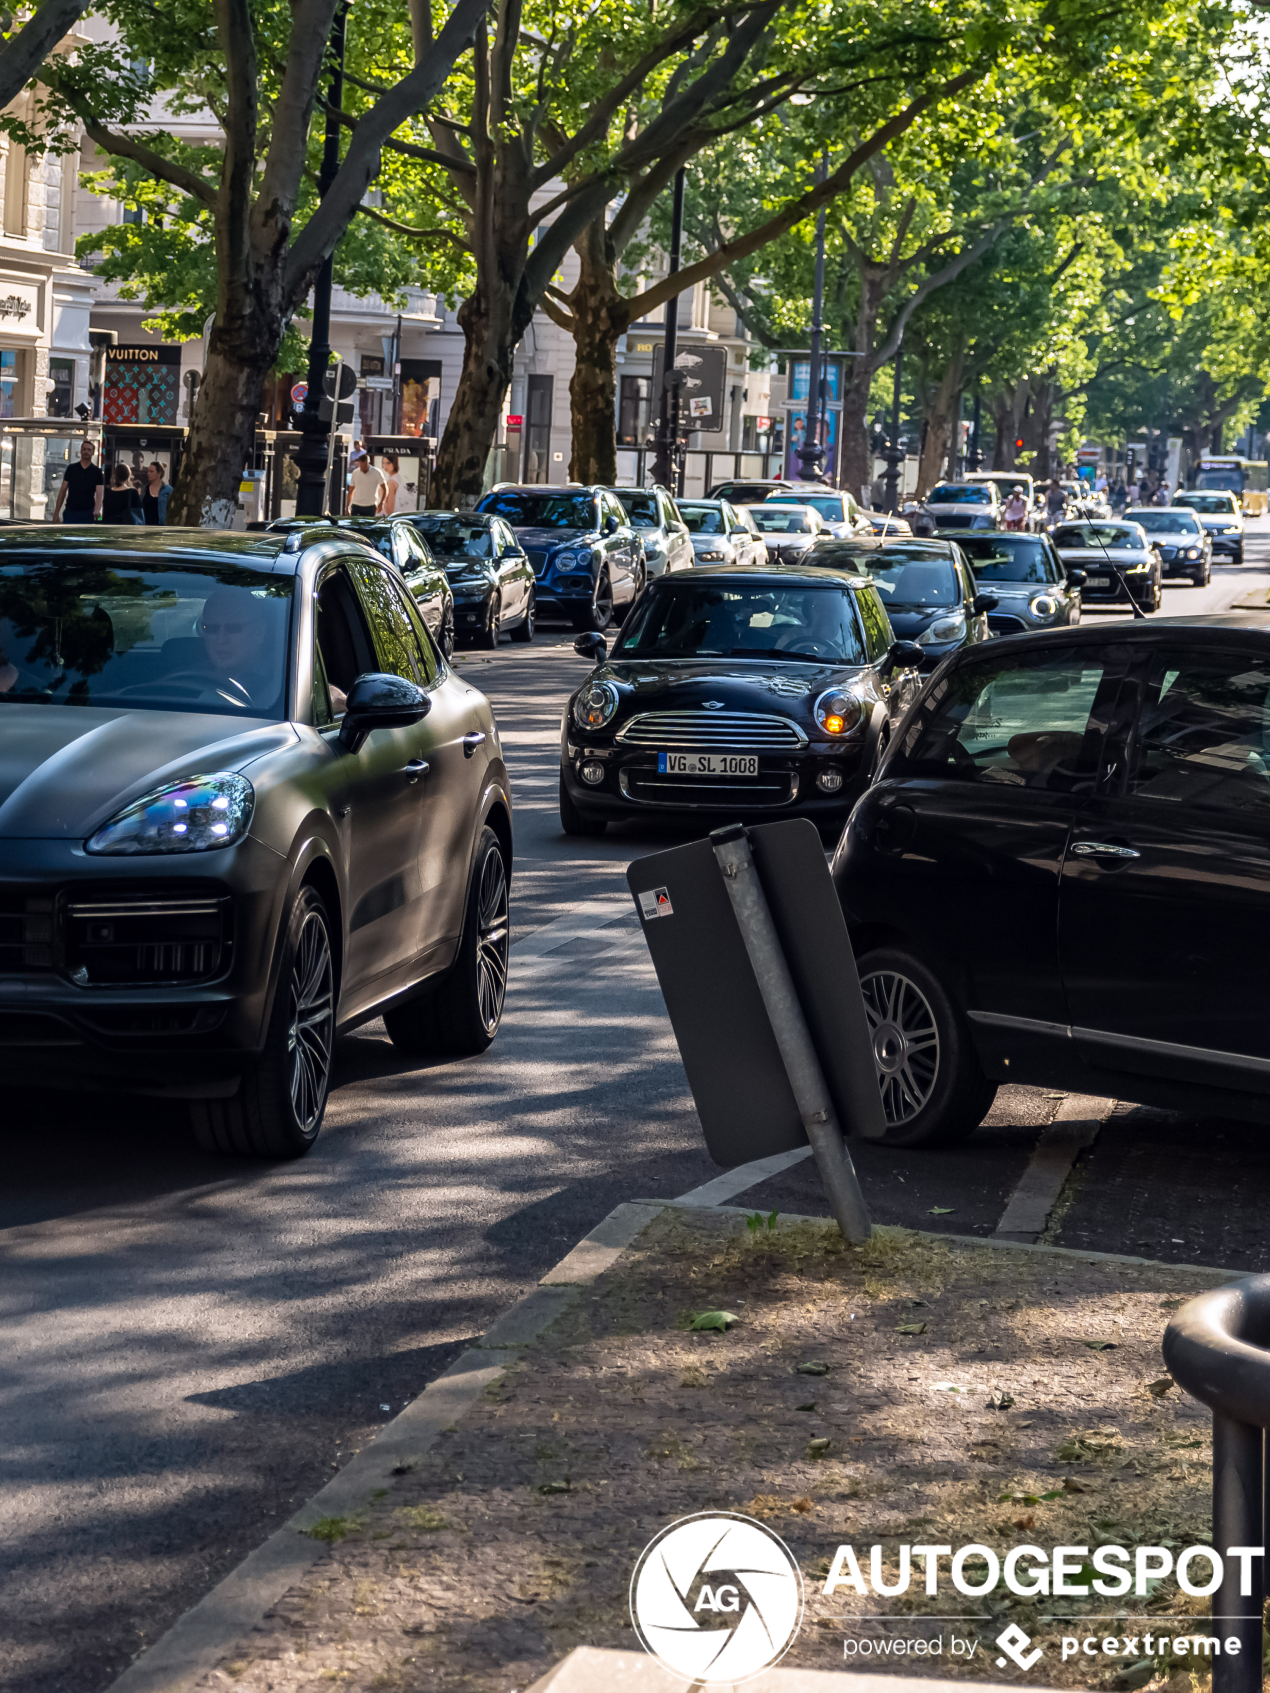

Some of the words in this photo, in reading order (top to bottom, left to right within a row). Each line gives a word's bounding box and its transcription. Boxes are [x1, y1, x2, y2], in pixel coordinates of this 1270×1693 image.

[108, 349, 159, 361] VUITTON
[383, 447, 411, 455] PRADA
[668, 755, 687, 772] VG
[698, 756, 716, 773] SL
[720, 757, 756, 774] 1008
